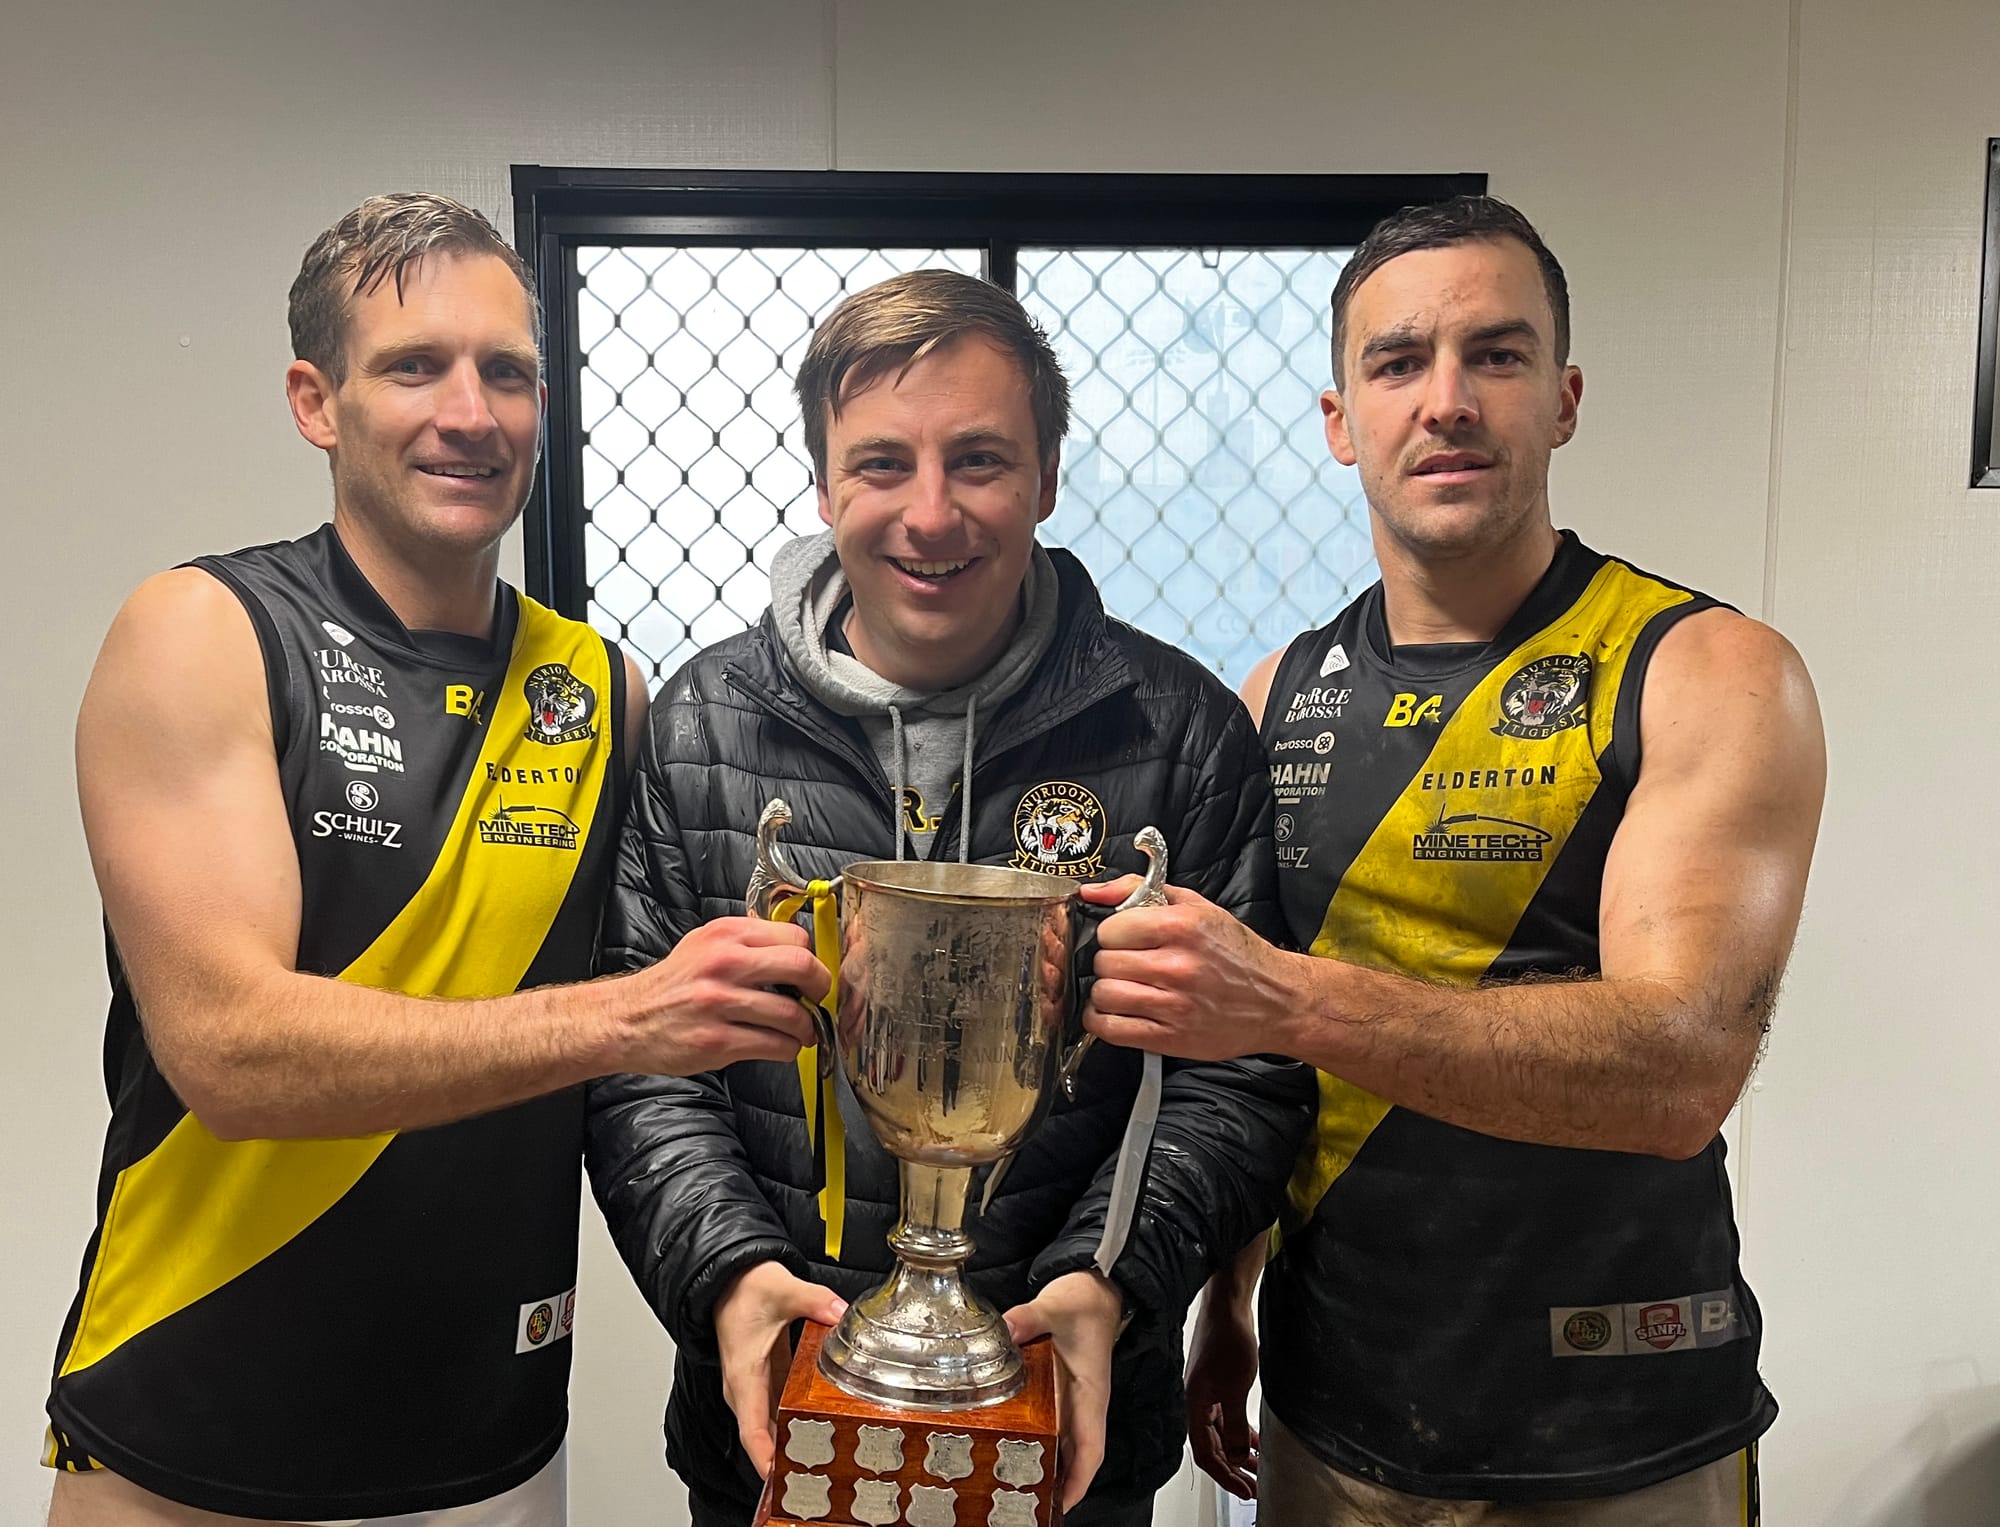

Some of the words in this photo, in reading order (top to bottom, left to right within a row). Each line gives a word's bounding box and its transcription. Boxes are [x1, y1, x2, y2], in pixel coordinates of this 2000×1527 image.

[537, 726, 587, 744] TIGERS
[1269, 762, 1331, 785] HAHN
[1422, 765, 1556, 791] ELDERTON
[1022, 785, 1100, 818] NURIOOTPA
[312, 811, 402, 848] SCHULZ
[483, 834, 576, 849] ENGINEERING
[1414, 849, 1540, 860] ENGINEERING
[1030, 859, 1088, 876] TIGERS
[1635, 1322, 1687, 1341] SANFL
